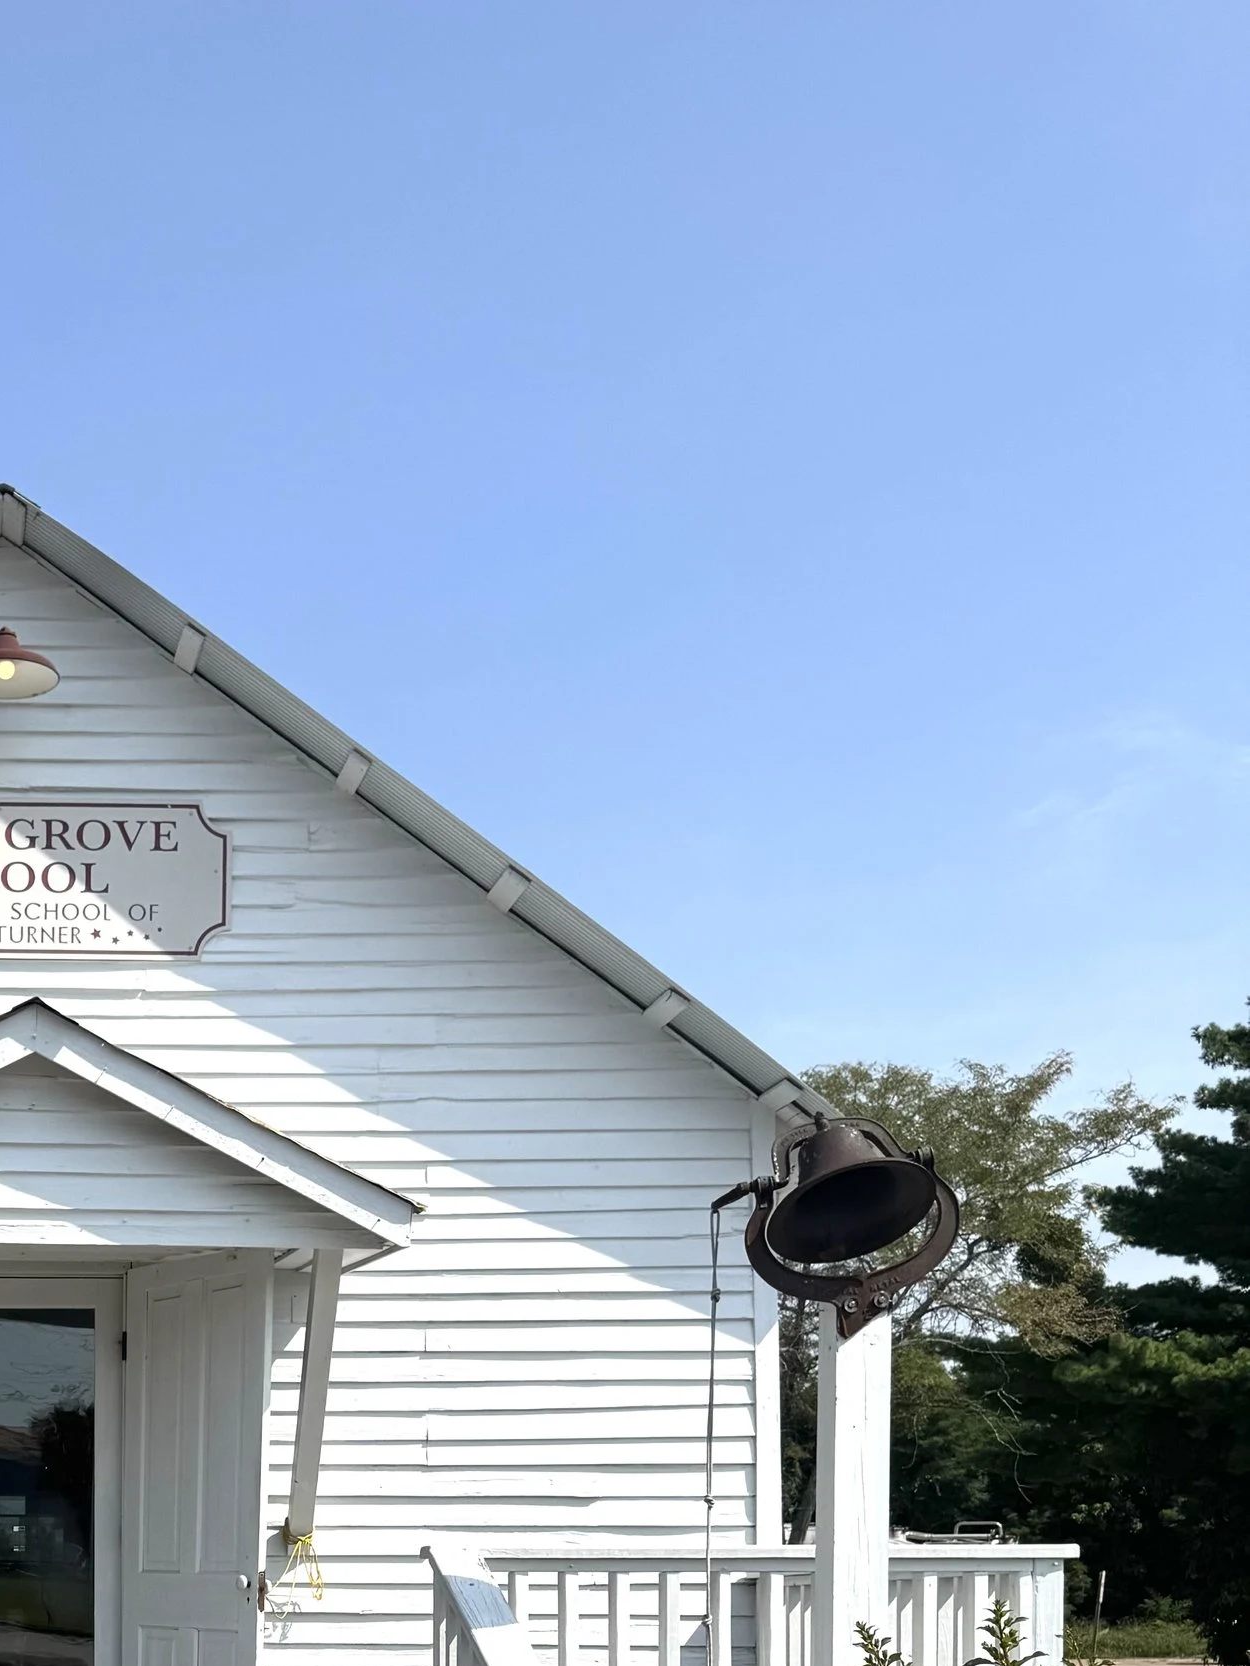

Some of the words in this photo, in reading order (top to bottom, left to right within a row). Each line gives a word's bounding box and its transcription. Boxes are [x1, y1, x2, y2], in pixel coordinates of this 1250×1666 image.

[4, 817, 180, 852] GROVE
[10, 902, 111, 922] SCHOOL
[128, 903, 159, 922] OF
